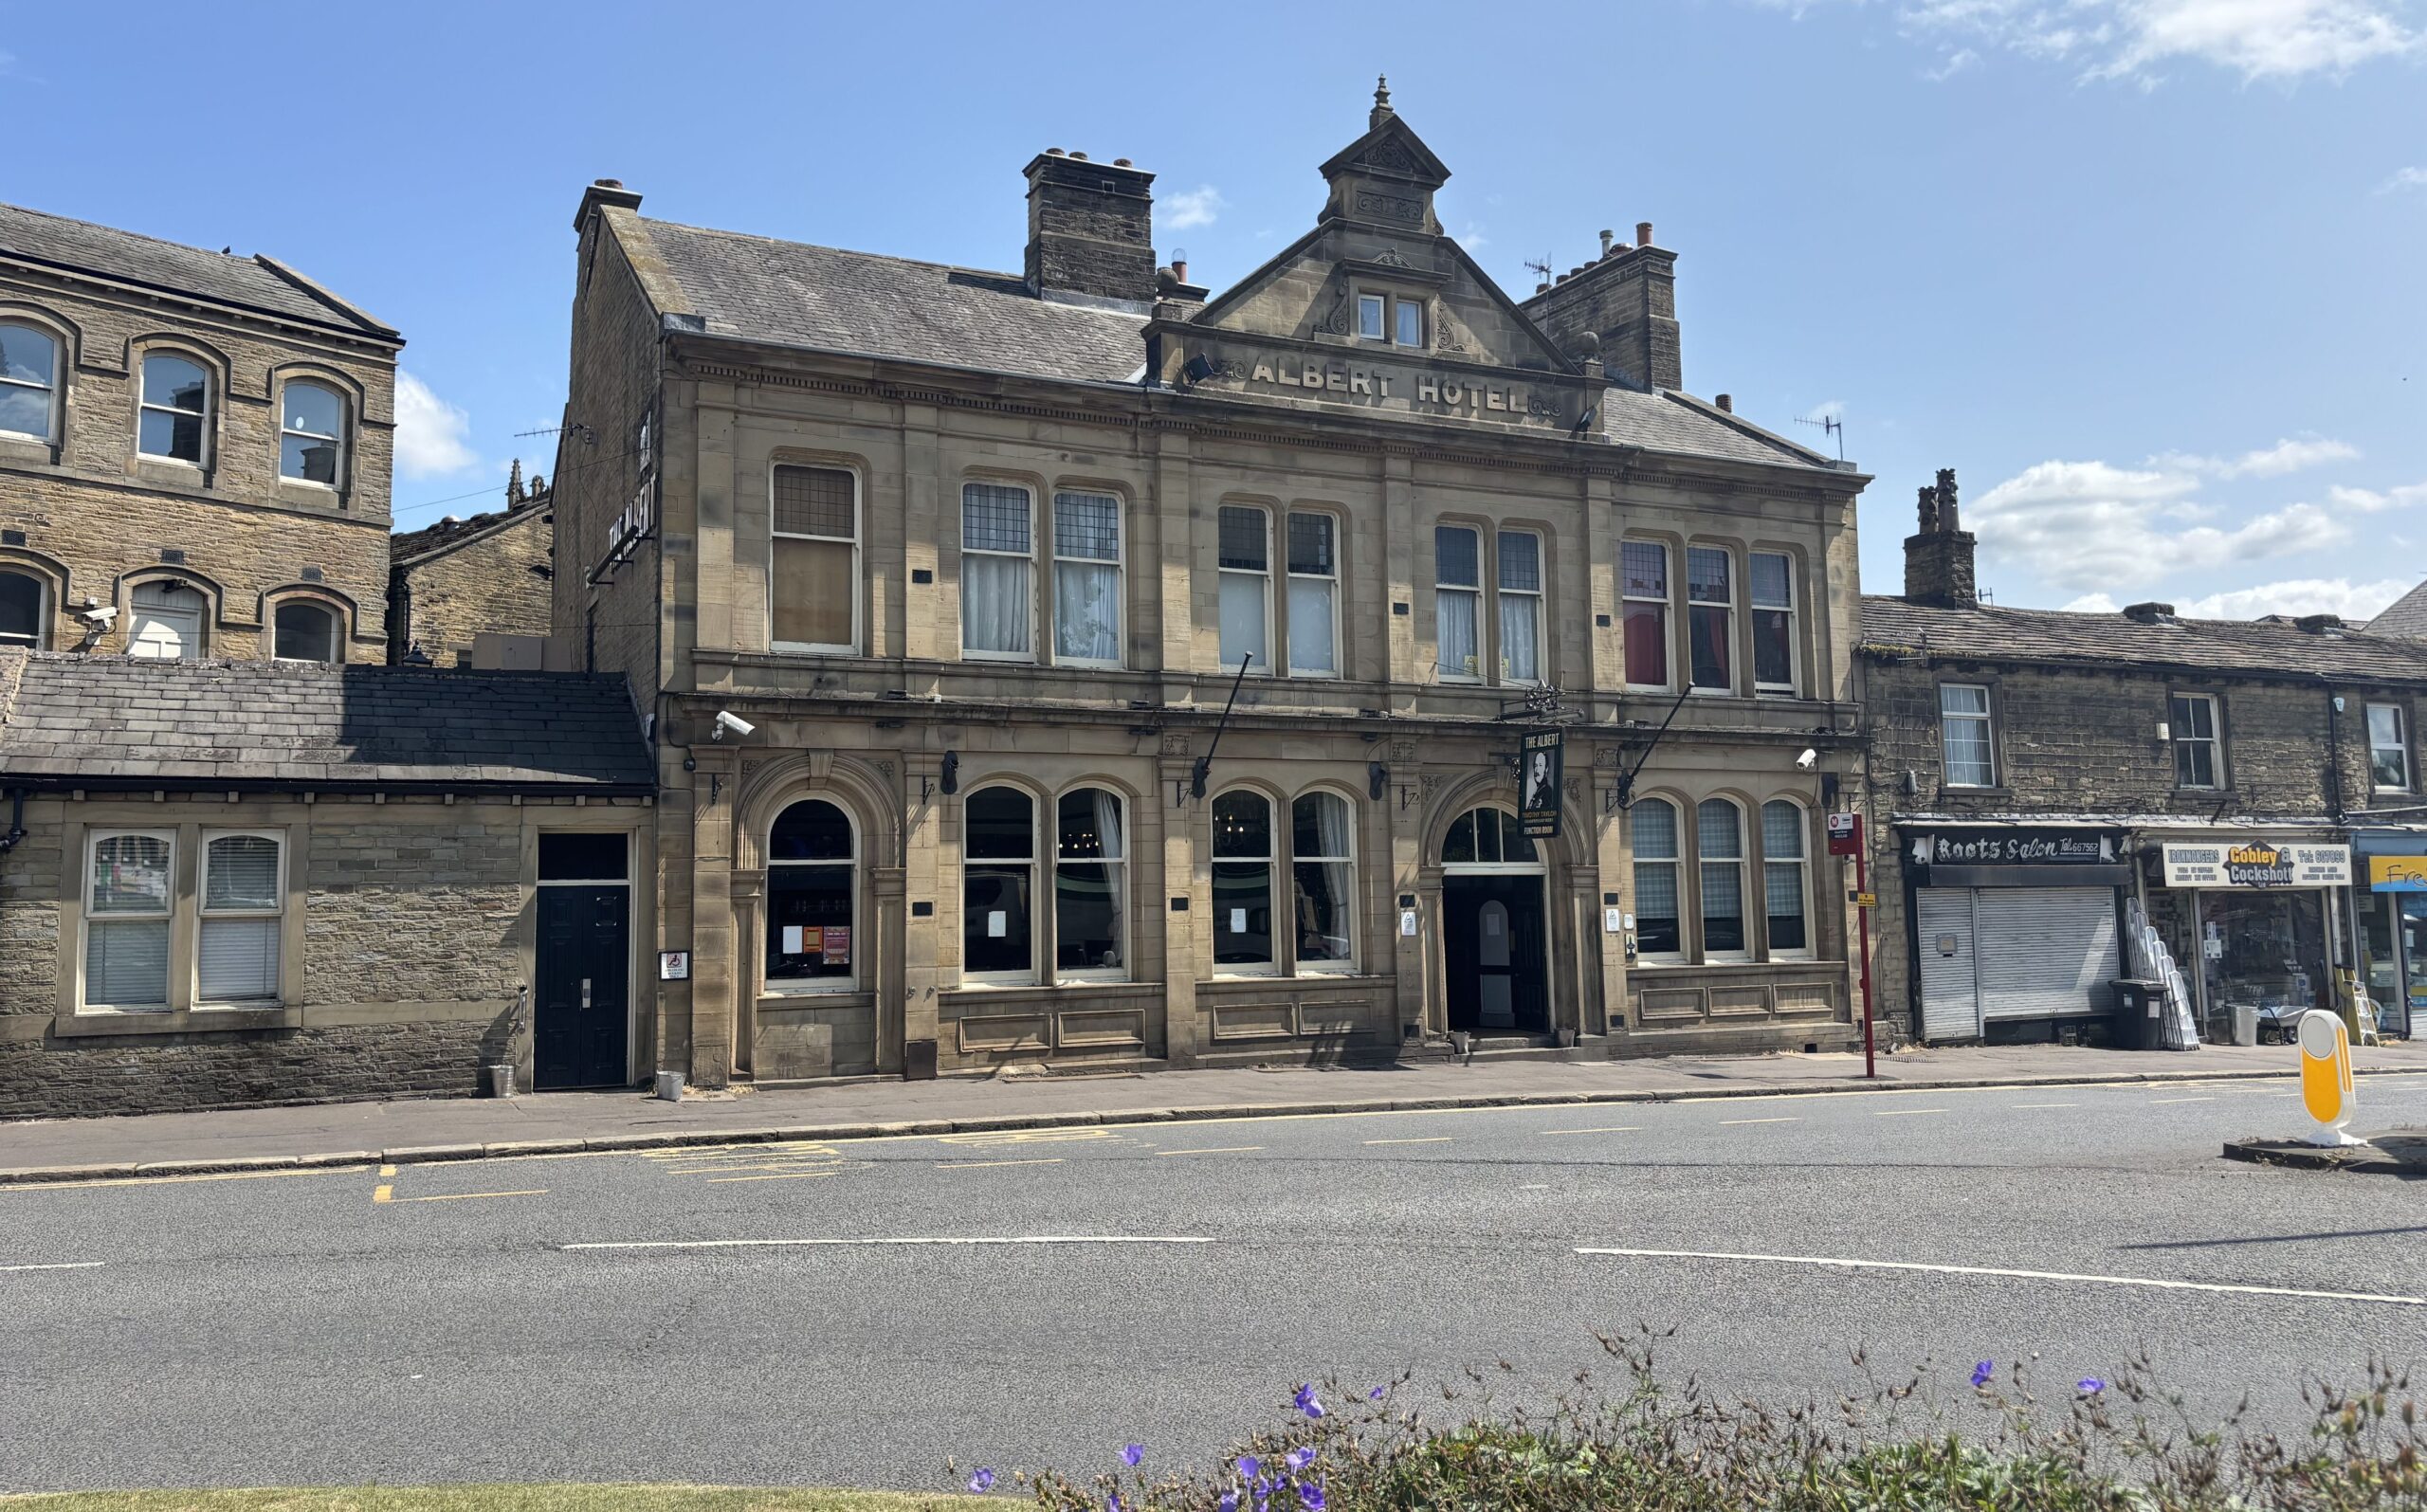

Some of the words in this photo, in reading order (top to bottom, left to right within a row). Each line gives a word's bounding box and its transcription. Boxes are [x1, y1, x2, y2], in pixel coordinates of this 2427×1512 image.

[1251, 356, 1394, 396] ALBERT
[1417, 375, 1528, 413] HOTEL
[610, 515, 623, 572] THE
[623, 472, 657, 556] ALBERT
[1525, 736, 1537, 749] THE
[1538, 733, 1560, 747] ALBERT
[1937, 837, 2001, 862] Roots
[2006, 837, 2058, 859] Salon
[2168, 849, 2219, 863] IRONMONGERS
[2229, 847, 2277, 867] Cobley
[2280, 847, 2290, 863] &
[2230, 865, 2293, 882] Cockshott
[2386, 864, 2427, 887] Fre
